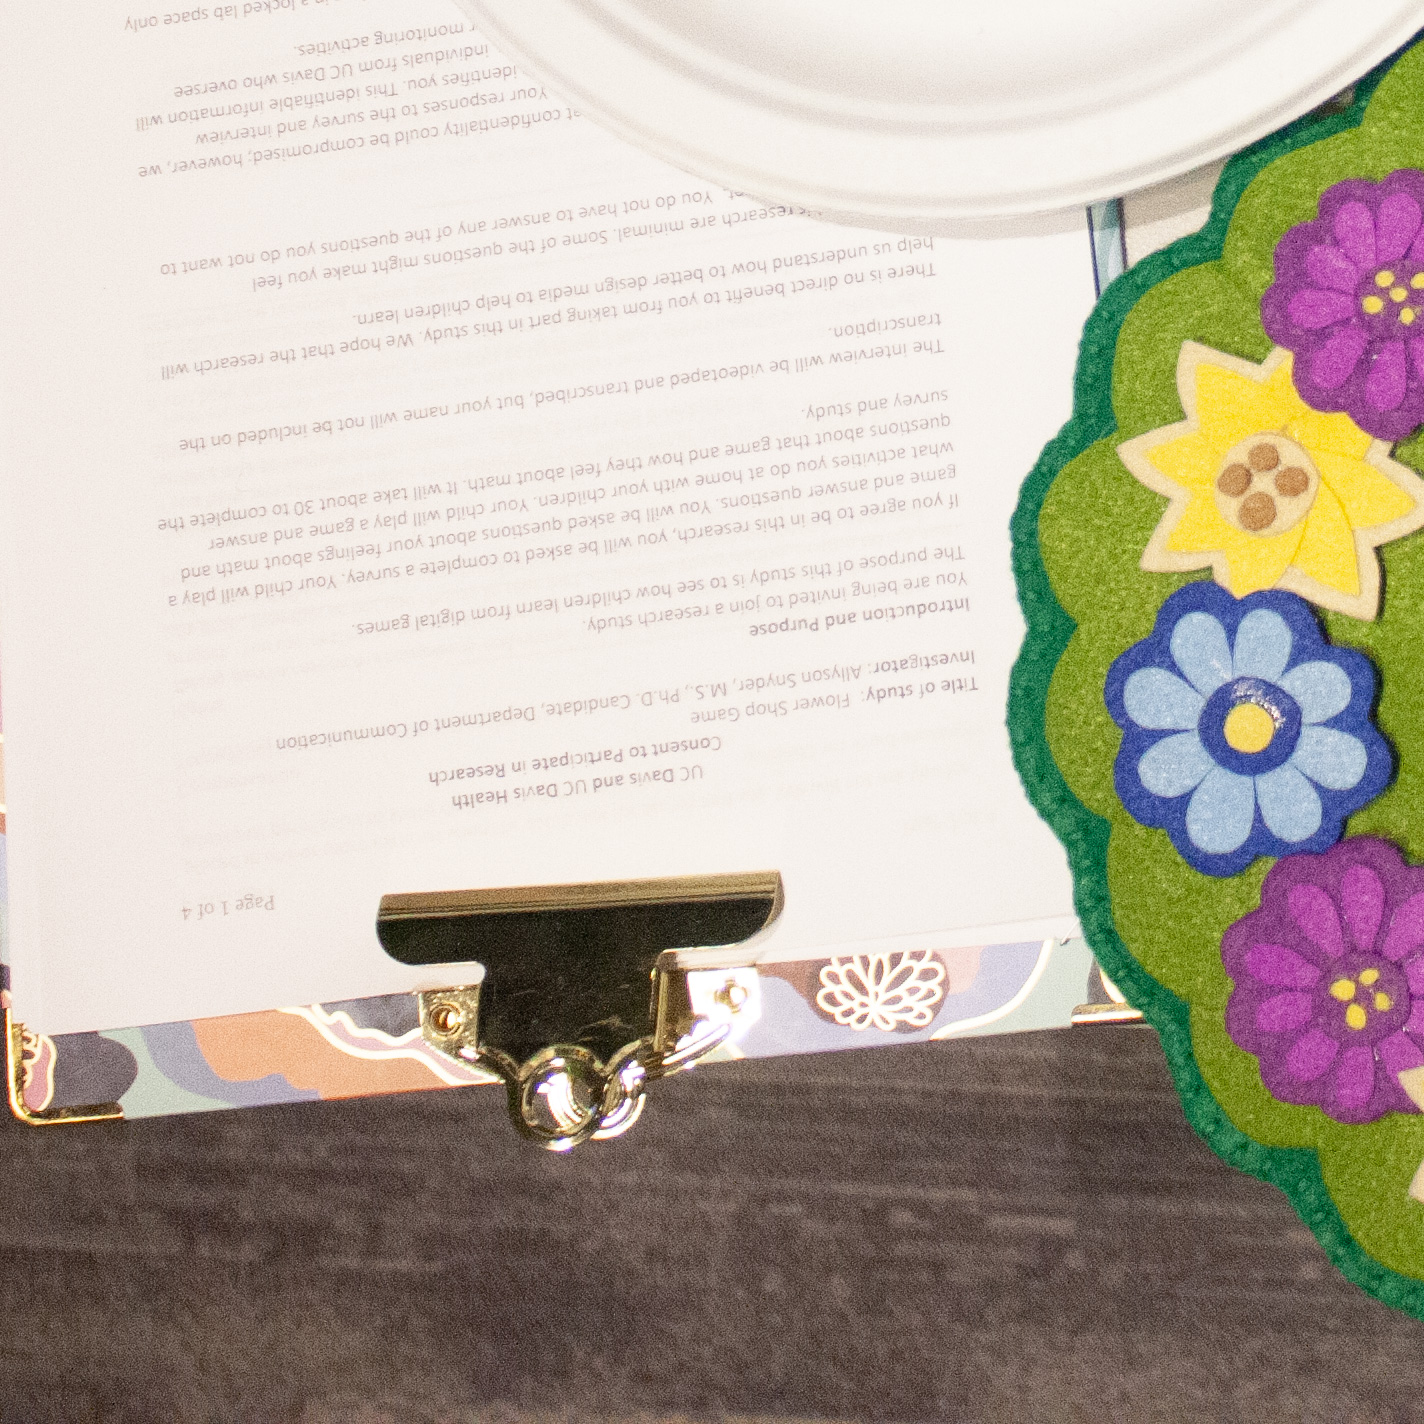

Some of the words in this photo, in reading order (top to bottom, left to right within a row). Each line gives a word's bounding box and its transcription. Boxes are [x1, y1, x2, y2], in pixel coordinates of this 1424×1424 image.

[163, 6, 209, 25] space
[213, 5, 238, 21] lab
[124, 15, 159, 33] only
[373, 23, 464, 46] monitoring
[293, 35, 370, 57] activities.
[403, 73, 438, 90] you.
[441, 65, 517, 87] identifies
[269, 87, 360, 112] identifiable
[365, 82, 399, 99] This
[509, 86, 548, 102] Your
[167, 100, 264, 124] information
[401, 104, 419, 117] to
[422, 92, 505, 114] responses
[135, 114, 164, 132] will
[312, 111, 365, 129] survey
[369, 107, 397, 123] the
[195, 125, 272, 145] interview
[276, 119, 307, 138] and
[843, 271, 865, 285] no
[869, 269, 882, 284] is
[887, 262, 937, 279] There
[725, 282, 786, 305] benefit
[790, 275, 839, 294] direct
[667, 291, 699, 309] you
[703, 291, 721, 305] to
[566, 305, 618, 323] taking
[623, 300, 664, 315] from
[473, 320, 504, 337] this
[508, 318, 524, 332] in
[528, 309, 563, 330] part
[828, 312, 942, 338] transcription.
[385, 333, 414, 348] We
[419, 325, 469, 345] study.
[301, 343, 336, 360] that
[339, 336, 381, 353] hope
[193, 352, 265, 376] research
[269, 348, 297, 364] the
[161, 363, 190, 380] will
[857, 397, 888, 416] and
[893, 389, 949, 407] survey
[801, 402, 853, 422] study.
[858, 547, 928, 569] purpose
[933, 545, 966, 562] The
[749, 566, 797, 587] study
[801, 562, 832, 580] this
[837, 559, 855, 577] of
[677, 579, 705, 593] see
[709, 575, 728, 589] to
[732, 574, 746, 588] is
[903, 575, 930, 590] are
[935, 571, 968, 587] You
[635, 583, 673, 599] how
[851, 580, 899, 597] being
[516, 598, 560, 615] learn
[563, 588, 633, 609] children
[729, 594, 761, 615] join
[765, 595, 784, 609] to
[788, 587, 846, 609] invited
[470, 604, 512, 621] from
[637, 605, 710, 628] research
[714, 602, 725, 615] a
[862, 596, 971, 623] Introduction
[352, 613, 411, 636] games.
[415, 608, 466, 631] digital
[583, 614, 634, 634] study.
[748, 617, 820, 637] Purpose
[824, 611, 857, 631] and
[867, 649, 976, 674] Investigator:
[732, 672, 797, 693] Snyder,
[801, 664, 862, 683] Allyson
[684, 682, 728, 701] M.S.,
[861, 684, 914, 704] study:
[919, 681, 936, 699] of
[940, 676, 980, 695] Title
[541, 694, 632, 717] Candidate,
[636, 688, 681, 707] Ph.D.
[792, 693, 850, 711] Flower
[690, 707, 741, 724] Game
[745, 700, 788, 718] Shop
[434, 705, 536, 732] Department
[275, 722, 409, 751] Communication
[412, 719, 430, 738] of
[628, 745, 649, 759] to
[651, 735, 723, 757] Consent
[511, 760, 527, 775] in
[531, 748, 624, 771] Participate
[428, 763, 506, 787] Research
[628, 768, 675, 787] Davis
[679, 764, 704, 782] UC
[512, 782, 559, 802] Davis
[563, 779, 588, 797] UC
[592, 774, 625, 794] and
[451, 789, 509, 811] Health
[220, 900, 229, 916] 1
[235, 893, 275, 911] Page
[180, 906, 193, 921] 4
[197, 902, 215, 921] of
